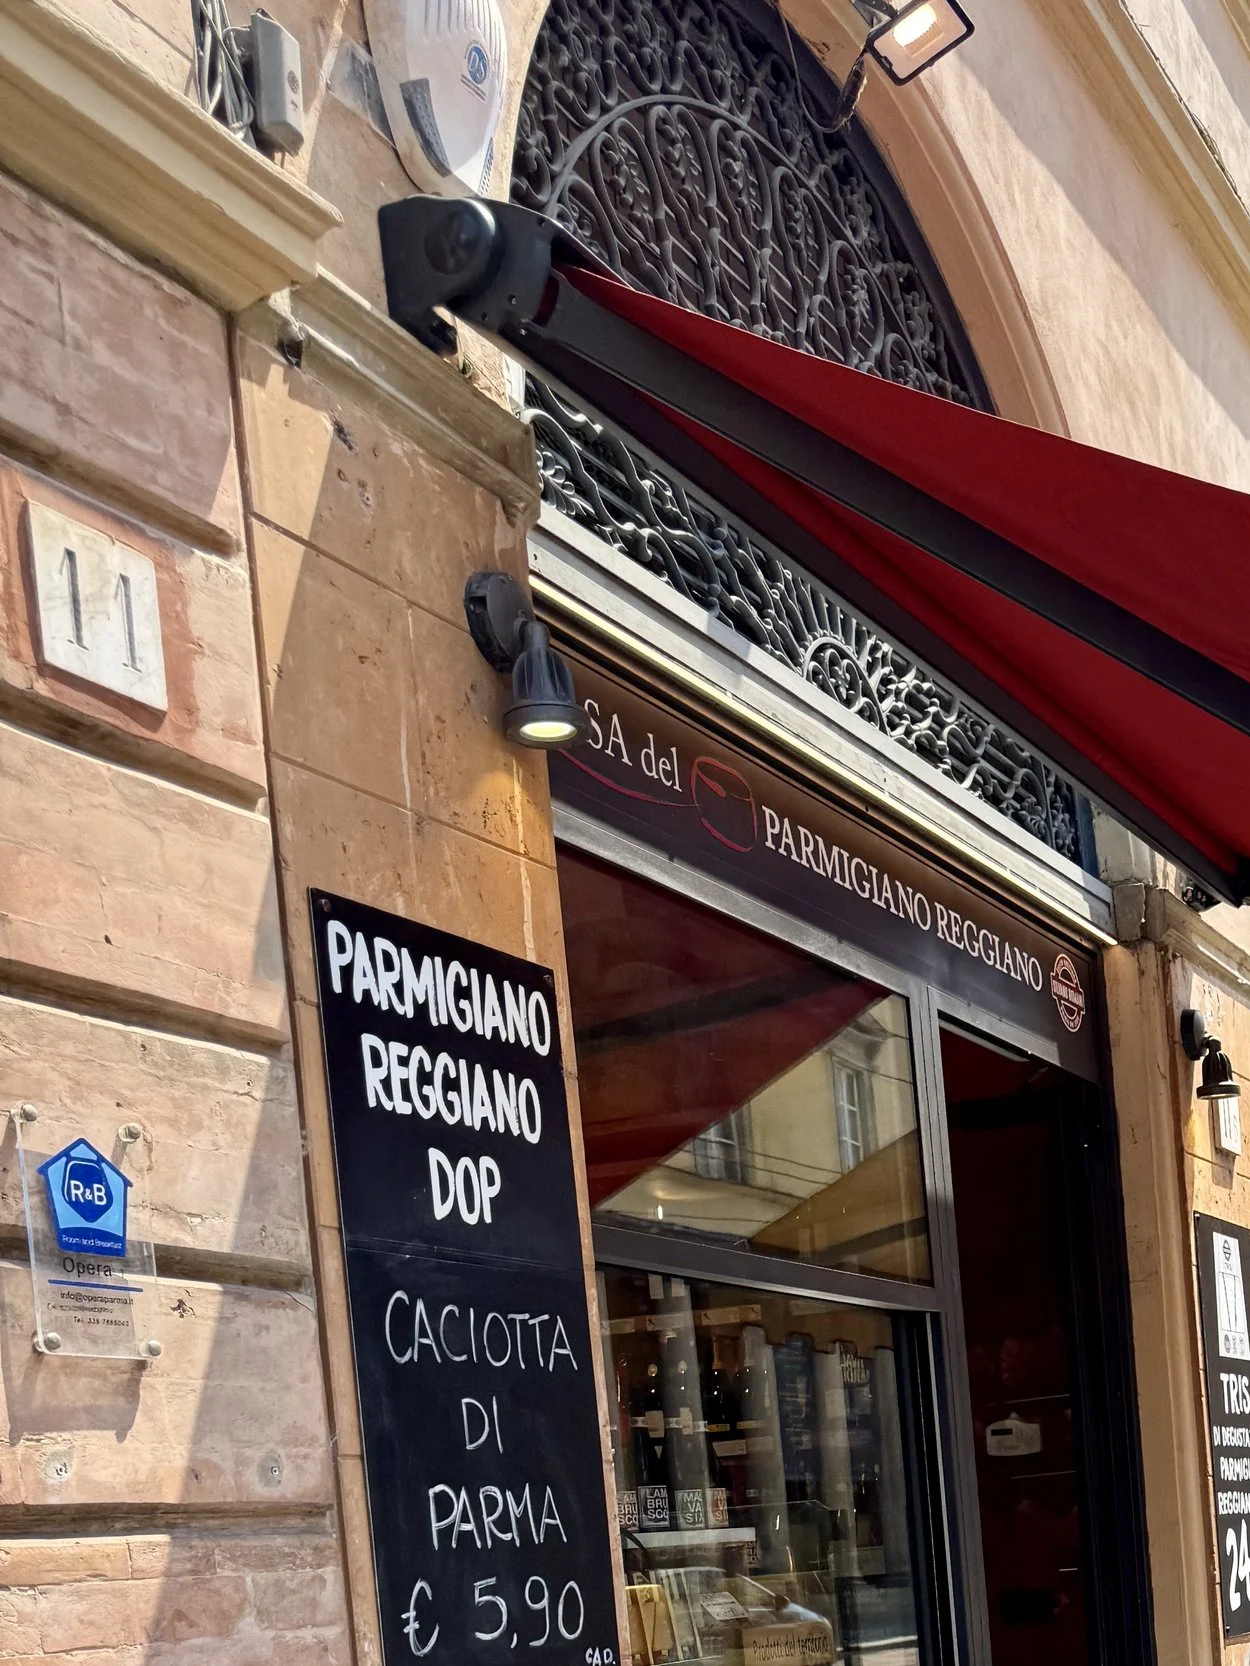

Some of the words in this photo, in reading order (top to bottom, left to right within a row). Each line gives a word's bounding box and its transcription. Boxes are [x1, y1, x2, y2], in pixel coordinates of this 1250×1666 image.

[59, 547, 143, 673] 11
[583, 698, 633, 767] SA
[640, 732, 683, 793] del
[761, 805, 932, 932] PARMIGIANO
[934, 901, 1044, 993] REGGIANO
[327, 919, 551, 1057] PARMIGIANO
[361, 1033, 542, 1145] REGGIANO
[70, 1180, 107, 1206] R&B
[428, 1147, 502, 1226] DOP
[63, 1256, 112, 1279] Opera
[385, 1289, 578, 1372] CACIOTTA
[461, 1395, 504, 1454] DI
[1219, 1372, 1250, 1415] TRIS
[1213, 1426, 1221, 1447] DI
[428, 1482, 568, 1551] PARMA
[401, 1577, 440, 1657] €
[474, 1575, 585, 1649] 5,90
